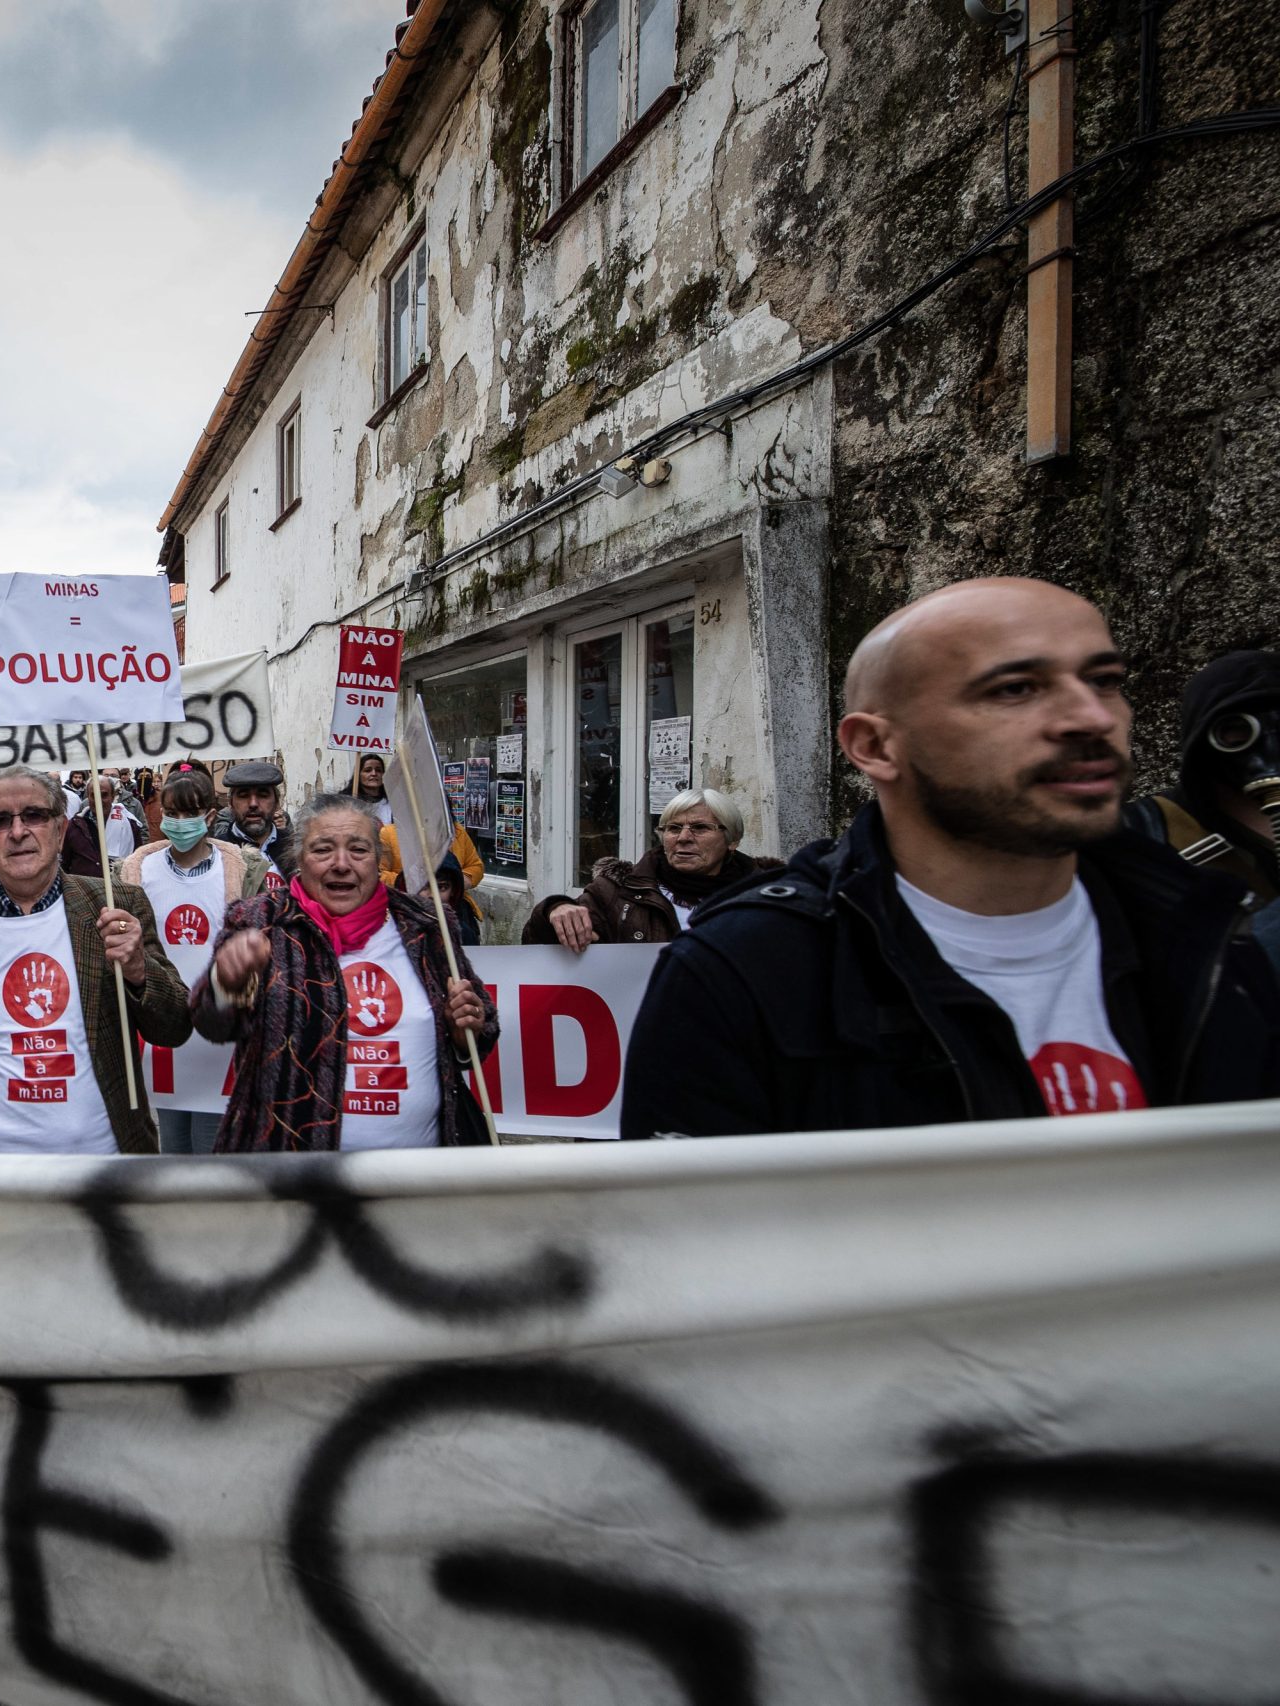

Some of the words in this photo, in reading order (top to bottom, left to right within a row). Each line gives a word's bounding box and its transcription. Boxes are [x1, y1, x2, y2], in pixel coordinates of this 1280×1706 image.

[45, 583, 99, 597] MINAS
[700, 599, 722, 625] 54
[348, 630, 395, 647] NÃO
[361, 651, 376, 666] À
[339, 672, 395, 689] MINA
[346, 693, 384, 708] SIM
[356, 712, 370, 727] À
[333, 733, 390, 749] VIDA!
[23, 1035, 56, 1050] Não
[352, 1046, 389, 1060] Não
[36, 1060, 46, 1074] à
[367, 1072, 378, 1086] à
[19, 1085, 64, 1099] mina
[348, 1097, 397, 1112] mina
